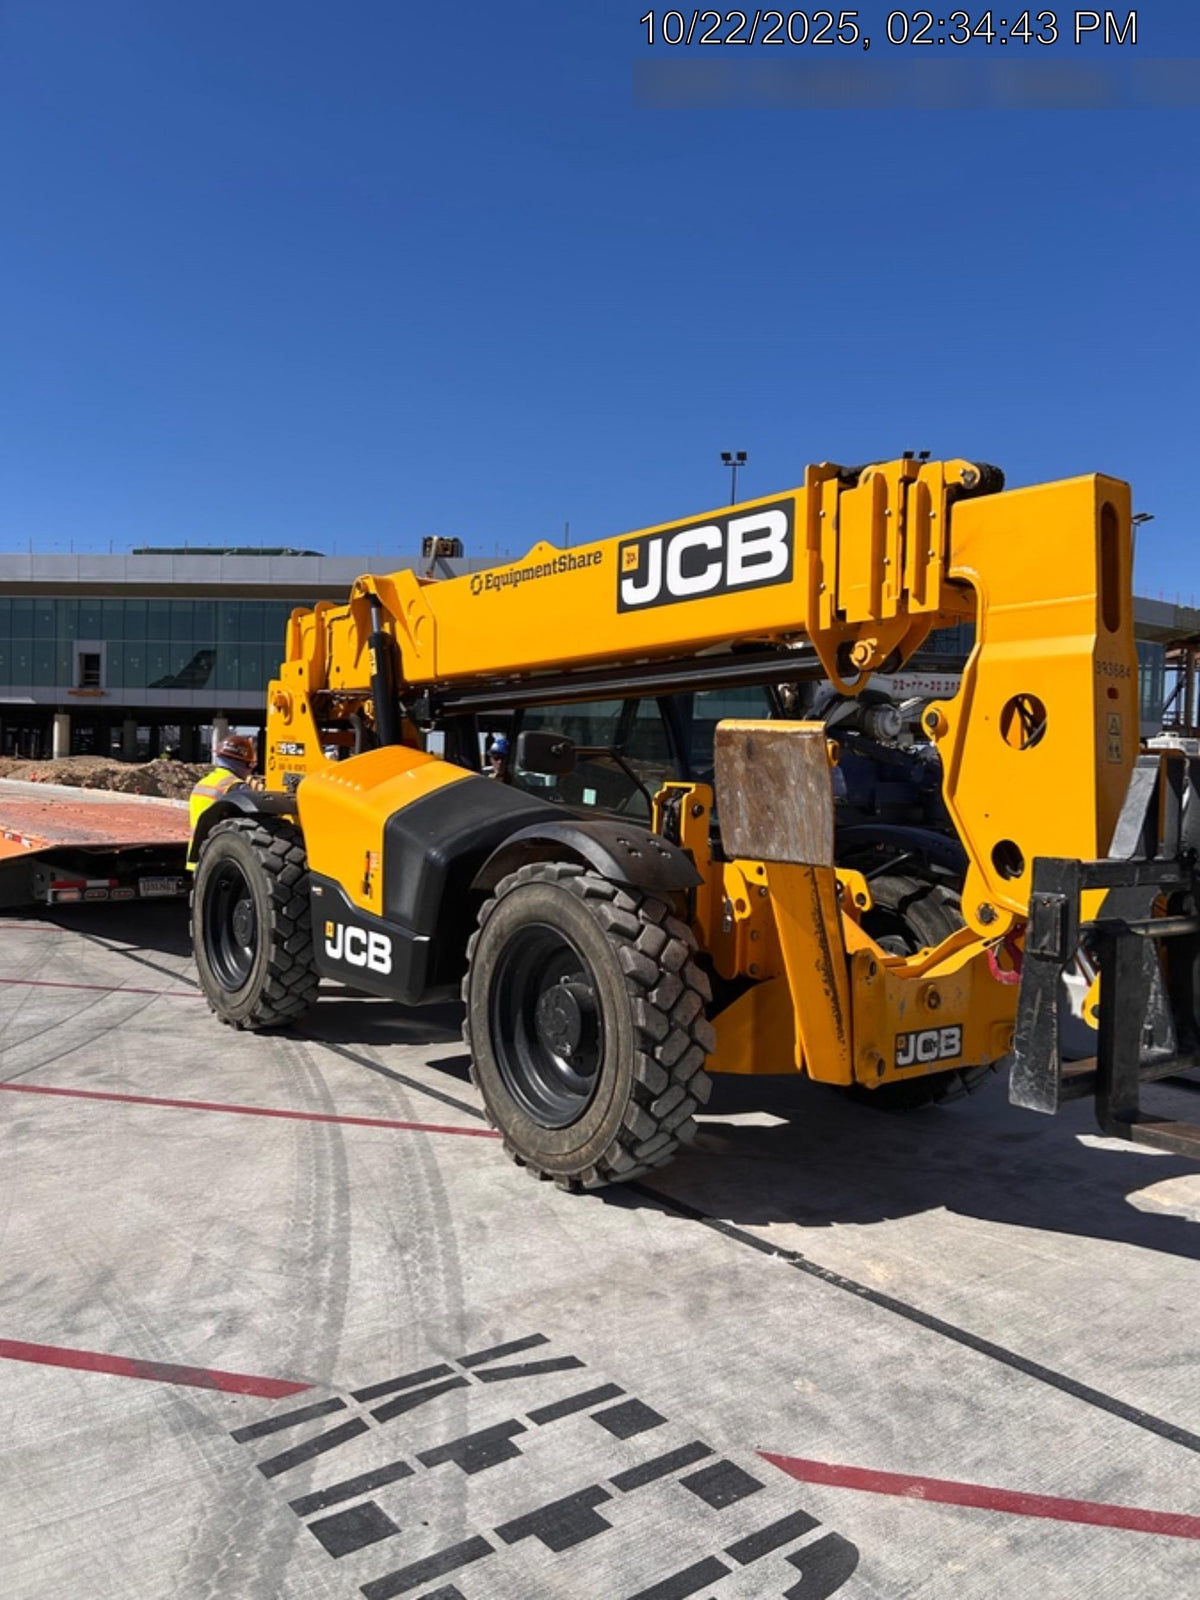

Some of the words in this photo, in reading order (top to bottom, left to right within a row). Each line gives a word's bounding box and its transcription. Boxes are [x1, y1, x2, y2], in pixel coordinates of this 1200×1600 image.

[484, 549, 603, 591] EquipmentShare
[621, 510, 790, 606] JCB
[325, 922, 392, 975] JCB
[896, 1026, 962, 1066] JCB
